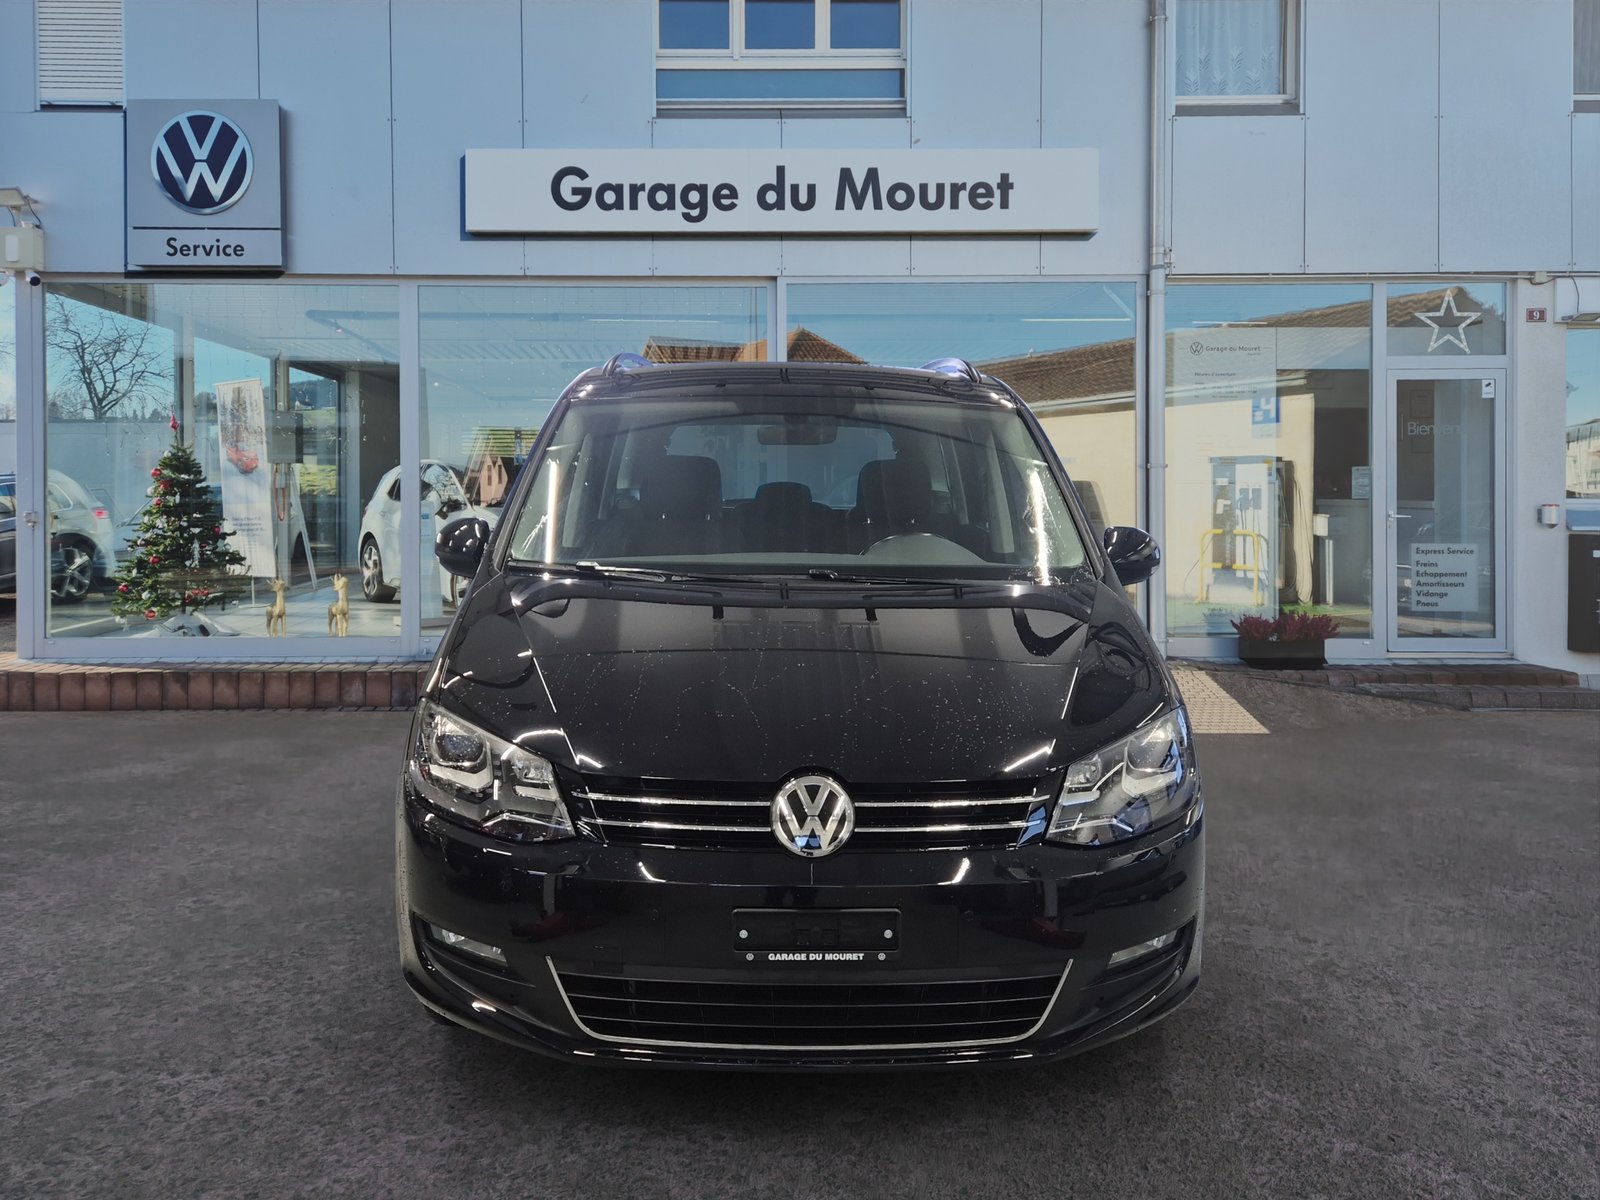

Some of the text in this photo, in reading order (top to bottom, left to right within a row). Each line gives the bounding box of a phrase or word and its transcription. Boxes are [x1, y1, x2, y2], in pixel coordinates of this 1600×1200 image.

[550, 165, 1014, 223] Garage du Mouret
[166, 237, 245, 257] Service
[1533, 310, 1540, 320] 9
[1205, 345, 1228, 353] Garage
[1416, 547, 1475, 556] Express Service
[1416, 560, 1438, 568] Freins
[1416, 570, 1468, 579] Echappement
[1416, 580, 1465, 588] Amortisseurs
[1416, 590, 1449, 599] Vidange
[768, 953, 864, 961] GARAGE DU MOURET
